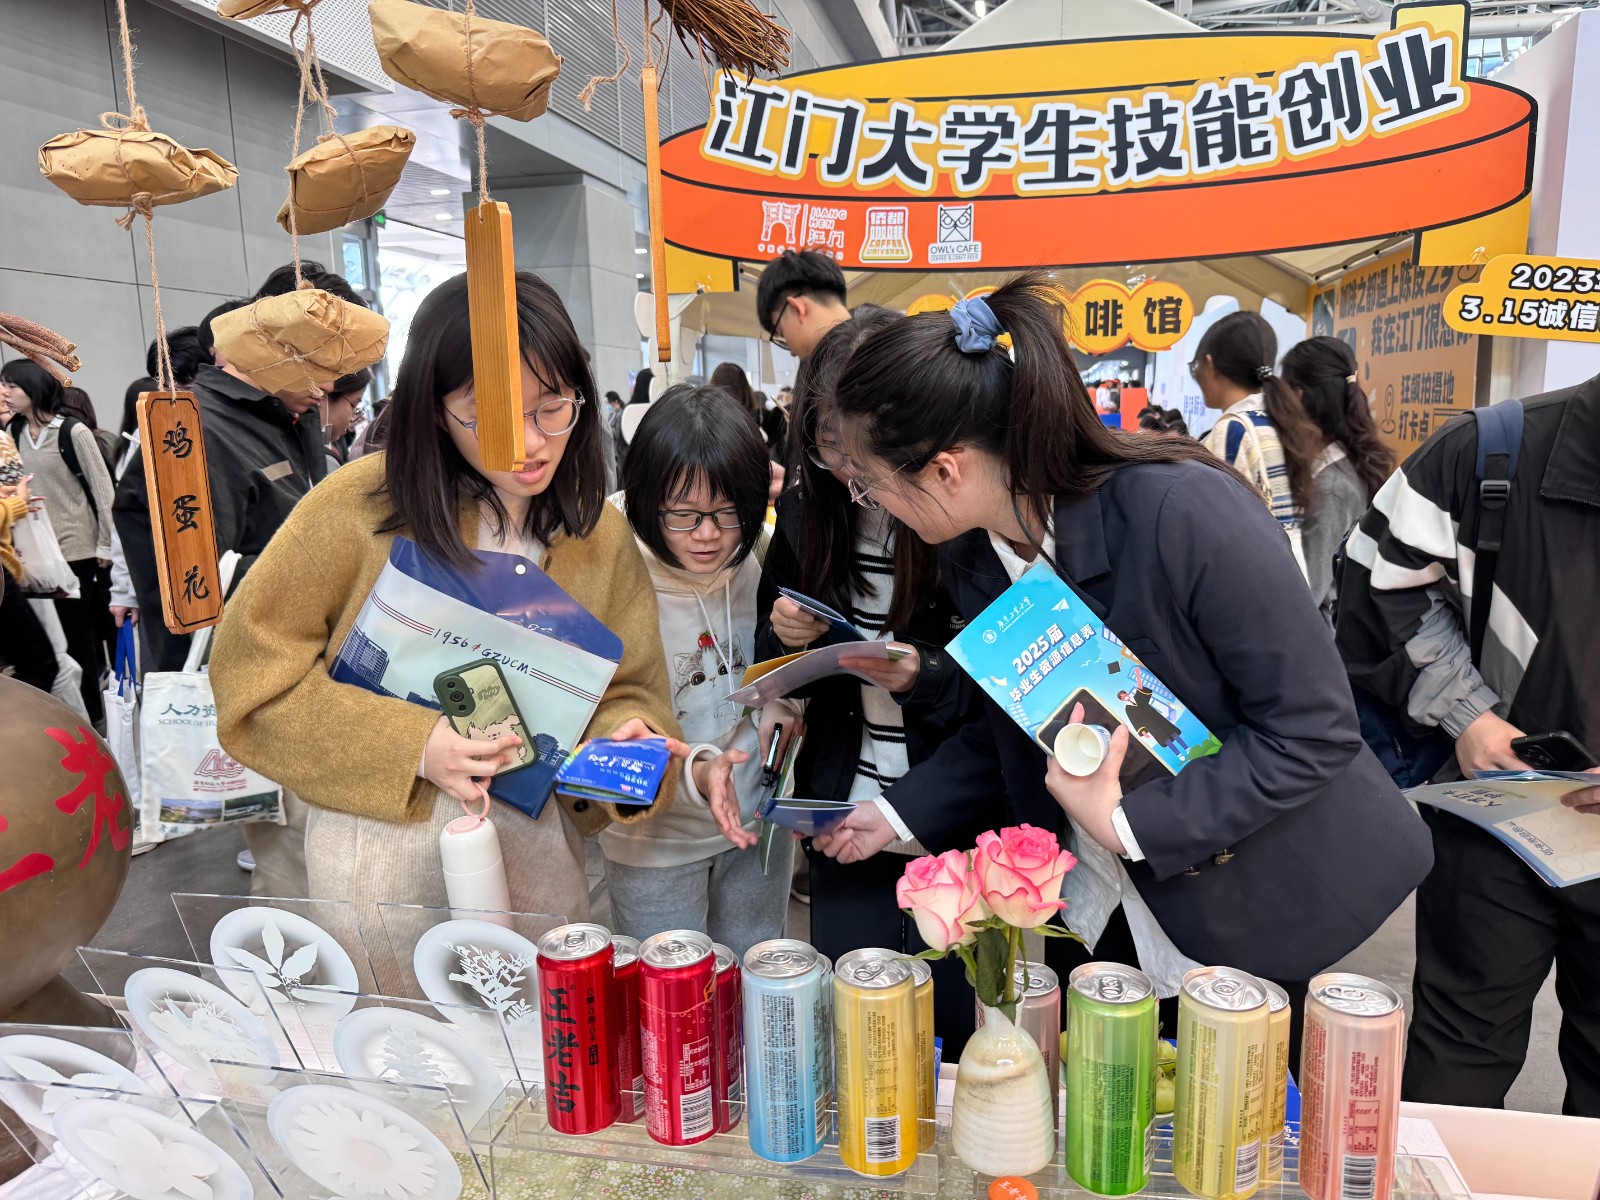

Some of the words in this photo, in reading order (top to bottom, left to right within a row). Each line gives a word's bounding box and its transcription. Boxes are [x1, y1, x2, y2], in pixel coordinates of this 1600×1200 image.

[708, 33, 1459, 187] 江门大学生技能创业
[809, 218, 834, 229] MEN
[810, 206, 847, 219] JIANG
[807, 229, 845, 248] 江门
[930, 245, 956, 255] OWL's
[956, 244, 980, 253] CAFE
[1085, 296, 1183, 337] 啡馆
[1459, 294, 1600, 332] 3.15诚信
[1399, 409, 1430, 441] 打卡点
[162, 420, 212, 605] 鸡蛋花
[433, 627, 469, 649] 1956
[480, 647, 530, 675] GZUCM
[1009, 623, 1097, 704] 毕业生资源信息表
[1012, 622, 1066, 676] 2025届
[158, 718, 195, 726] SCHOOL
[545, 985, 581, 1114] 王老吉
